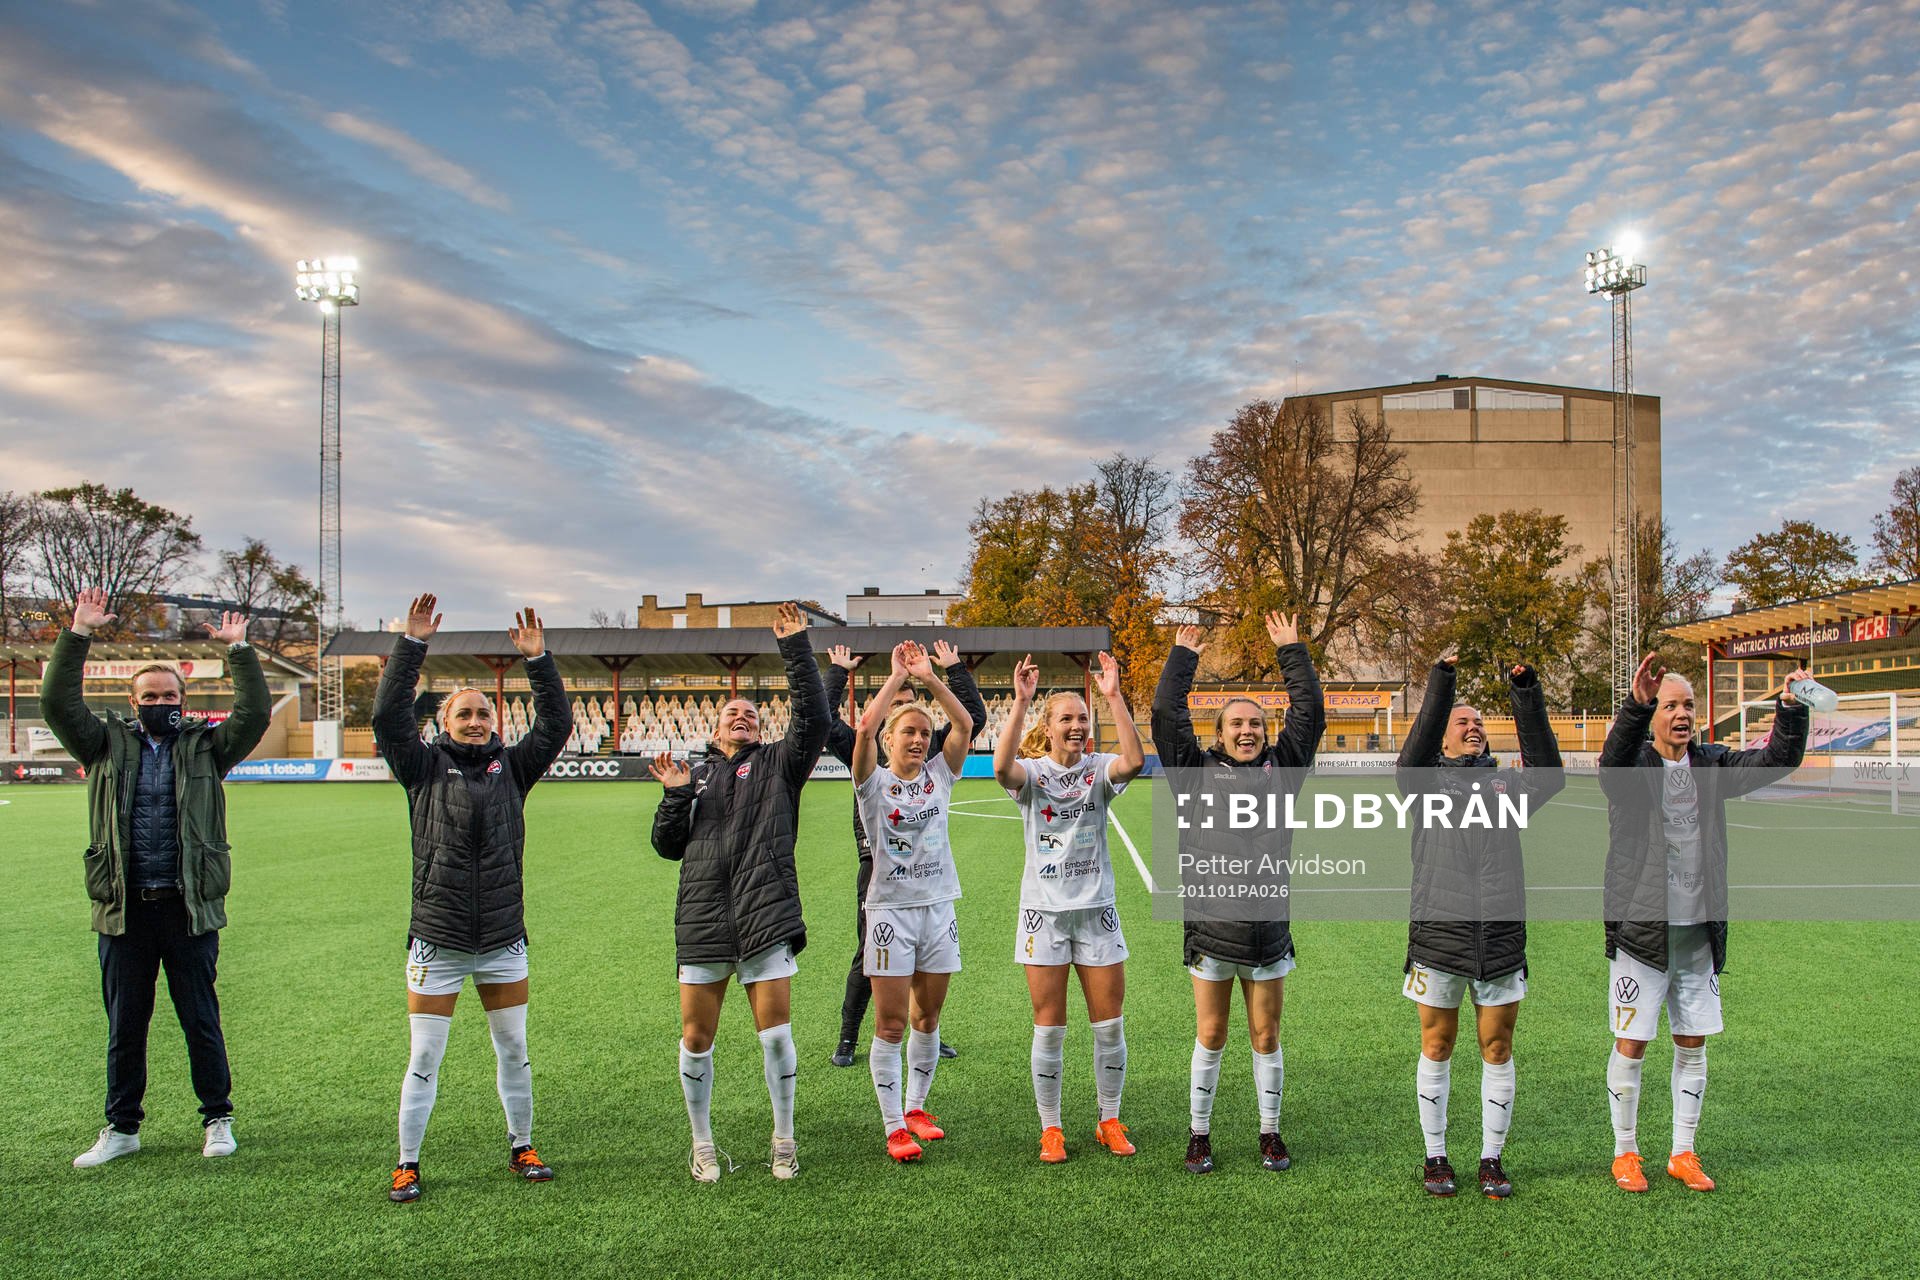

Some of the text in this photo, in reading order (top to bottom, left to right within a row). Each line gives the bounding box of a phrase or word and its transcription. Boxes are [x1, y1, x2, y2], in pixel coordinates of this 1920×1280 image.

[1855, 616, 1885, 641] FCR
[1733, 638, 1768, 654] HATTRICK
[1769, 636, 1779, 650] BY
[1779, 635, 1789, 649] FC
[231, 763, 272, 775] svensk
[914, 868, 923, 879] of
[1064, 859, 1096, 869] Embassy
[1065, 866, 1101, 878] of Sharing
[876, 948, 889, 970] 11
[1406, 967, 1429, 996] 15
[1615, 1005, 1637, 1031] 17
